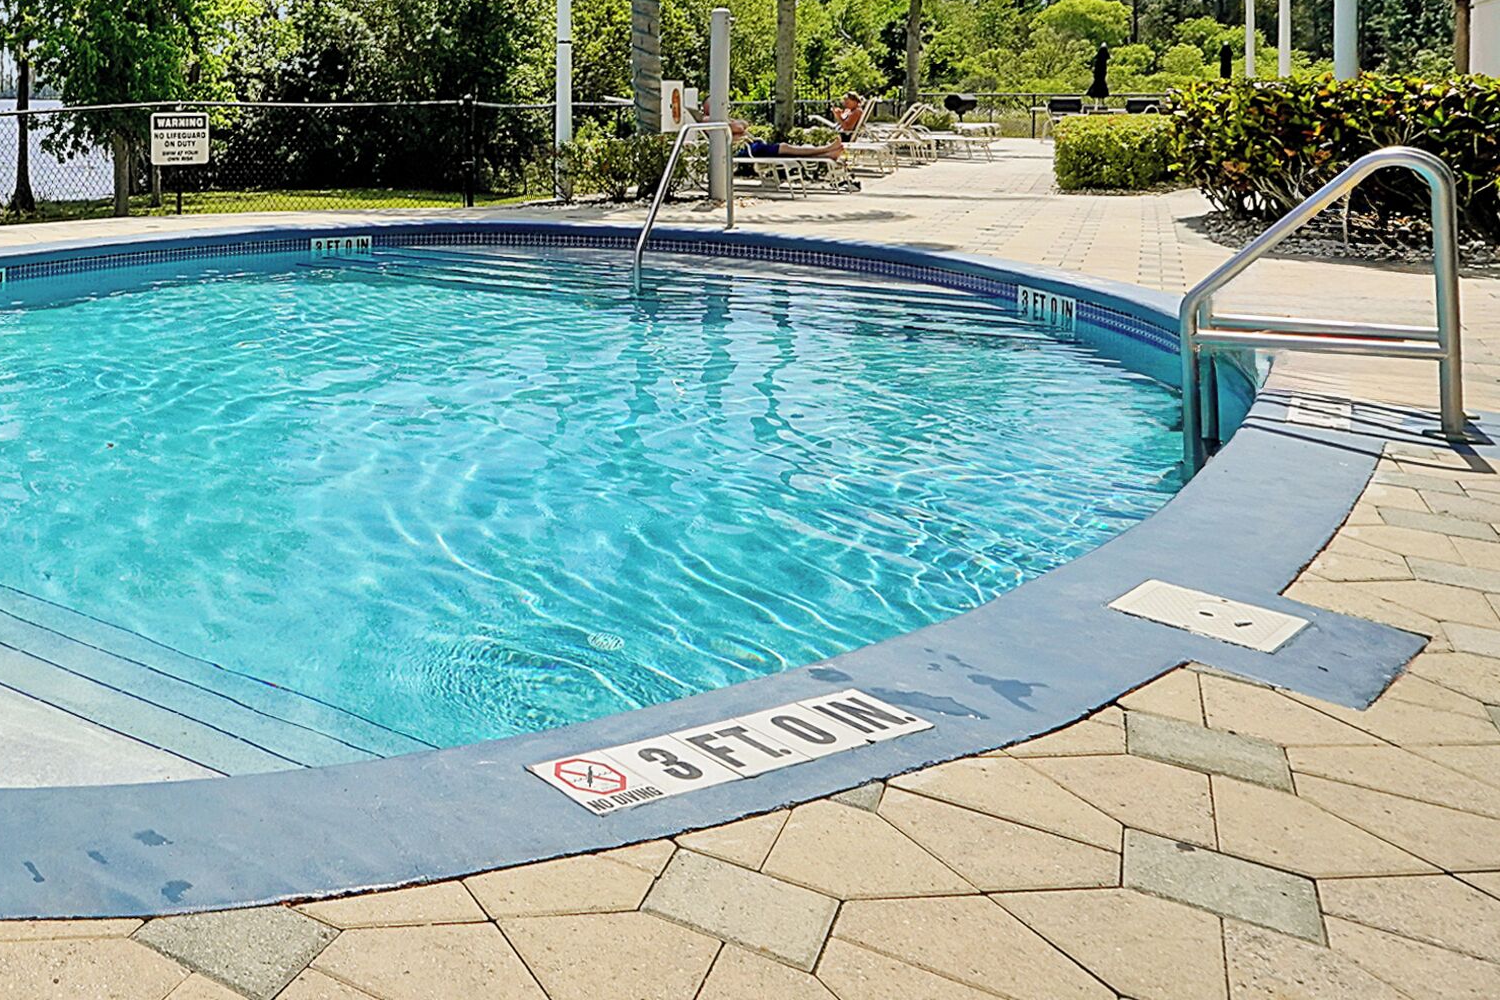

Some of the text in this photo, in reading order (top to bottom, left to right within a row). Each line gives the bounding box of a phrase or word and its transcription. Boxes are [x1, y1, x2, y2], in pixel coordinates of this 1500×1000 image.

[157, 118, 204, 128] WARNING
[357, 238, 369, 249] IN
[1062, 299, 1073, 318] IN
[637, 747, 704, 781] 3
[685, 725, 792, 769] FT.
[812, 696, 918, 734] IN.
[587, 786, 664, 811] NO DIVING
